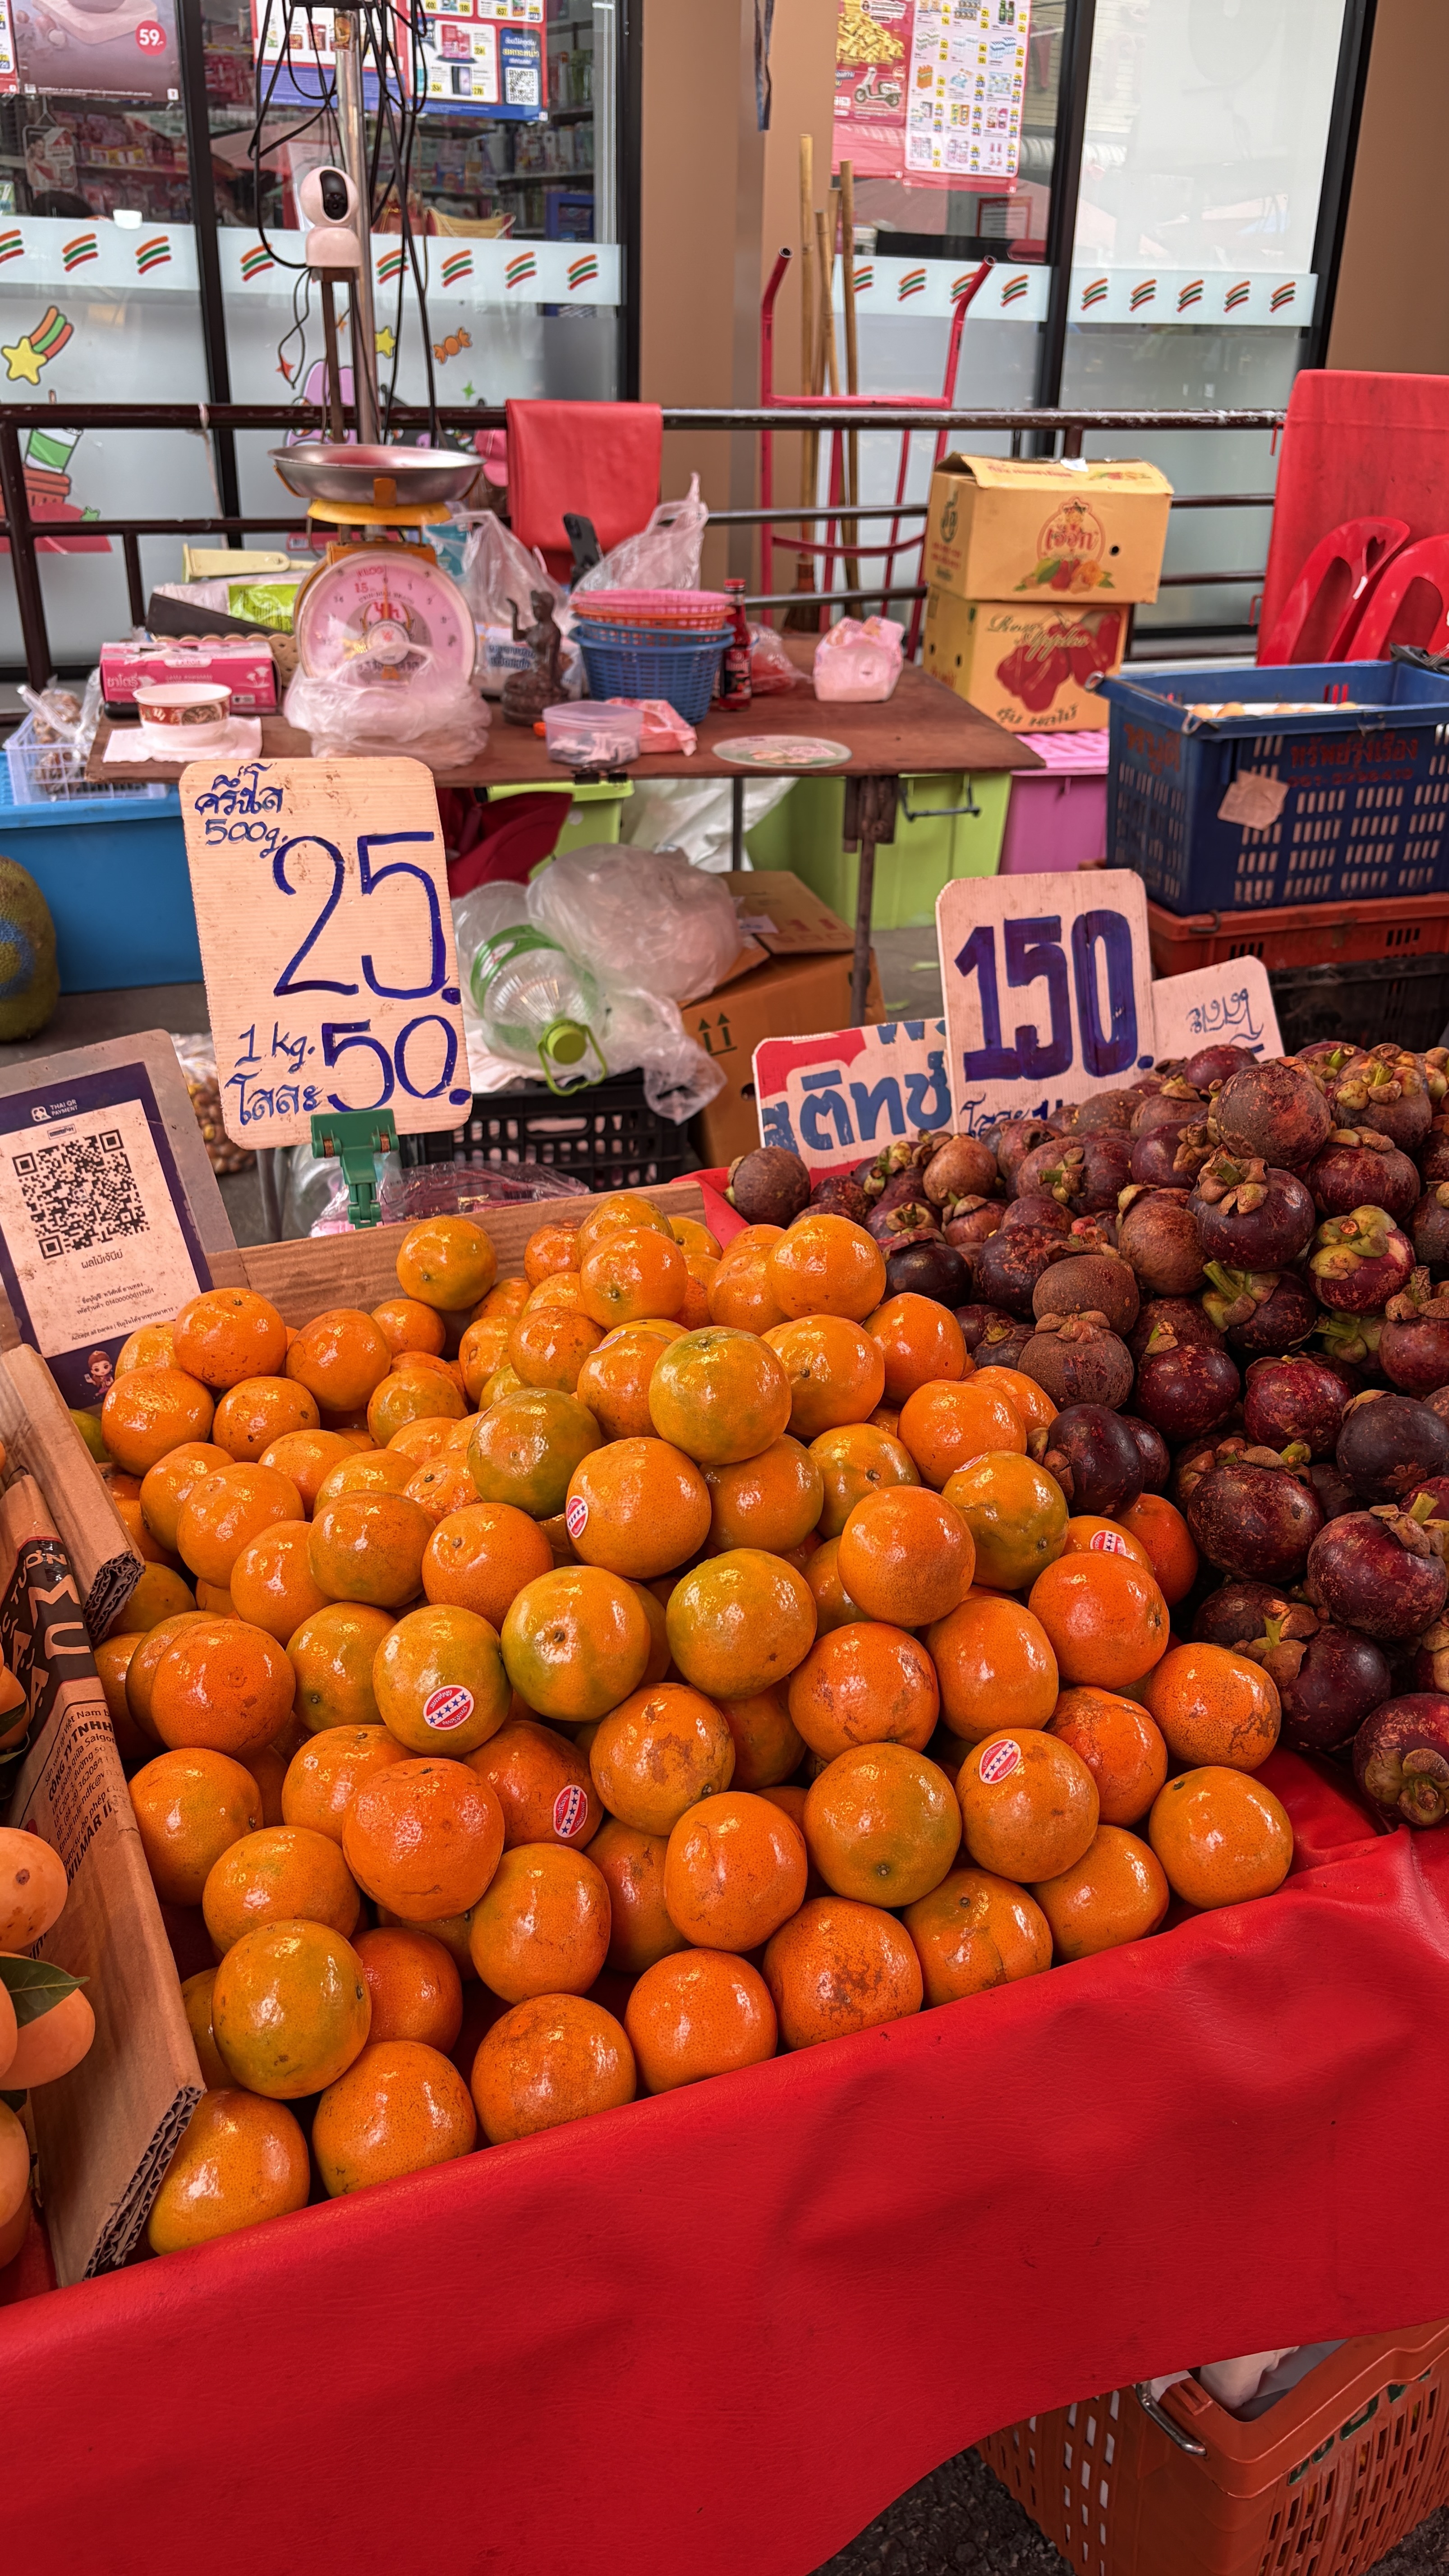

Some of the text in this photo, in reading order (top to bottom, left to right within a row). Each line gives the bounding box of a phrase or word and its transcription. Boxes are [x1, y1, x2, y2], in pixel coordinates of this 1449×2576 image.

[50, 1102, 66, 1110] THAI
[51, 1105, 78, 1116] PAYMENT
[71, 1332, 90, 1341] Accept
[97, 1325, 113, 1334] banks
[64, 1715, 75, 1734] Việt
[76, 1709, 101, 1720] Nam
[48, 1763, 65, 1802] CÔNG
[71, 1720, 114, 1743] TNHH
[89, 1791, 106, 1819] phép
